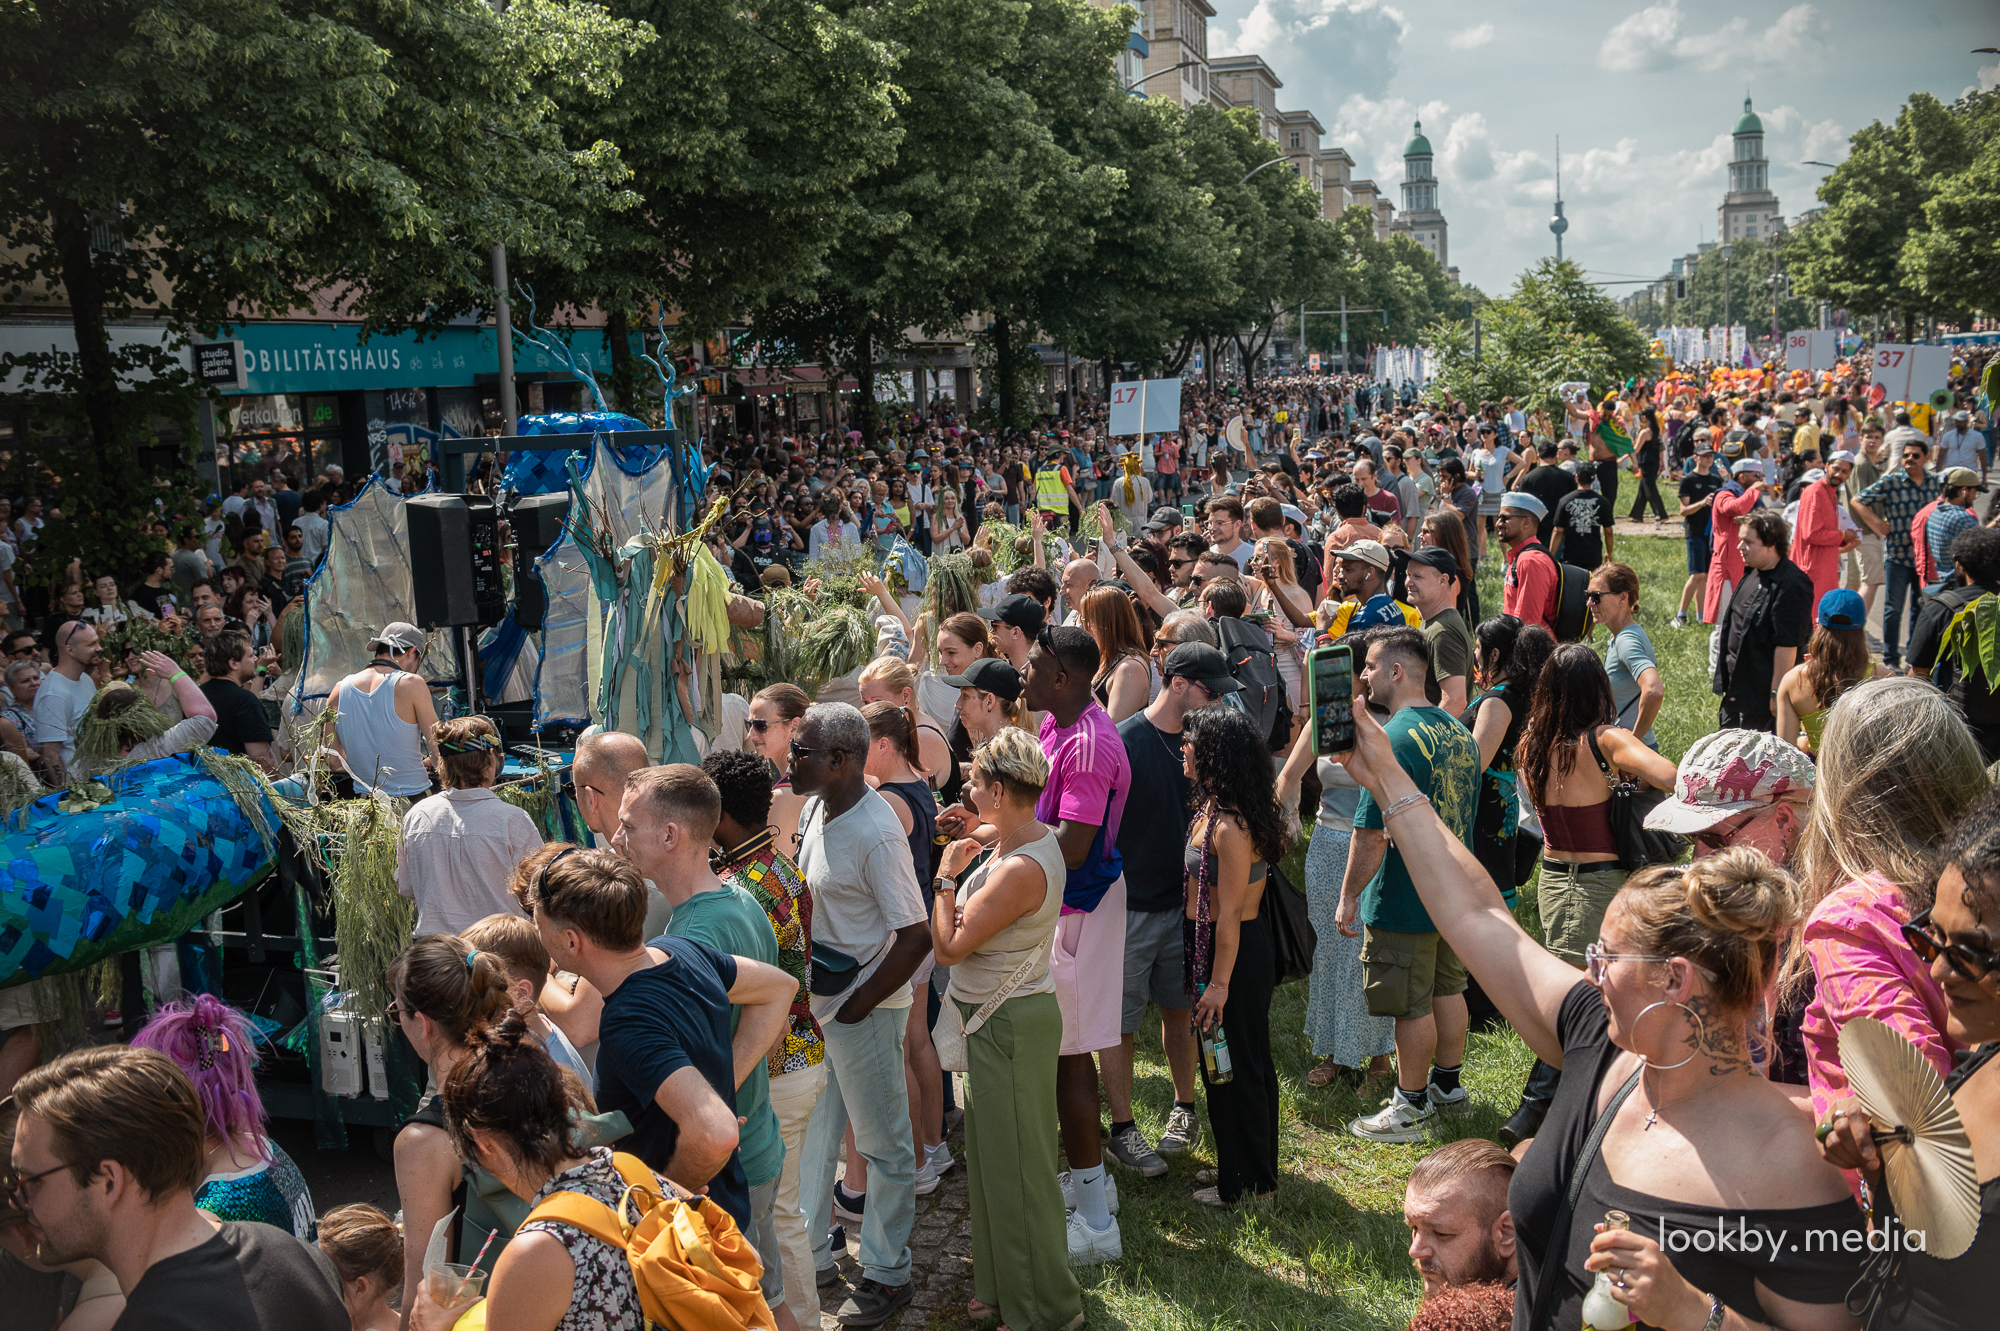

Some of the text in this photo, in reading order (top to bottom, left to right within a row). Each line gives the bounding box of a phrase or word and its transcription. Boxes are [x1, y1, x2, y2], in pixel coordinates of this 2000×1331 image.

[1789, 336, 1807, 348] 36
[201, 348, 229, 359] studio
[243, 343, 400, 374] OBILITÄTSHAUS
[1877, 350, 1905, 368] 37
[202, 357, 233, 369] galerie
[203, 367, 229, 377] berlin
[1114, 387, 1138, 405] 17
[314, 402, 332, 420] .de
[980, 961, 1033, 1019] MICHAEL KORS
